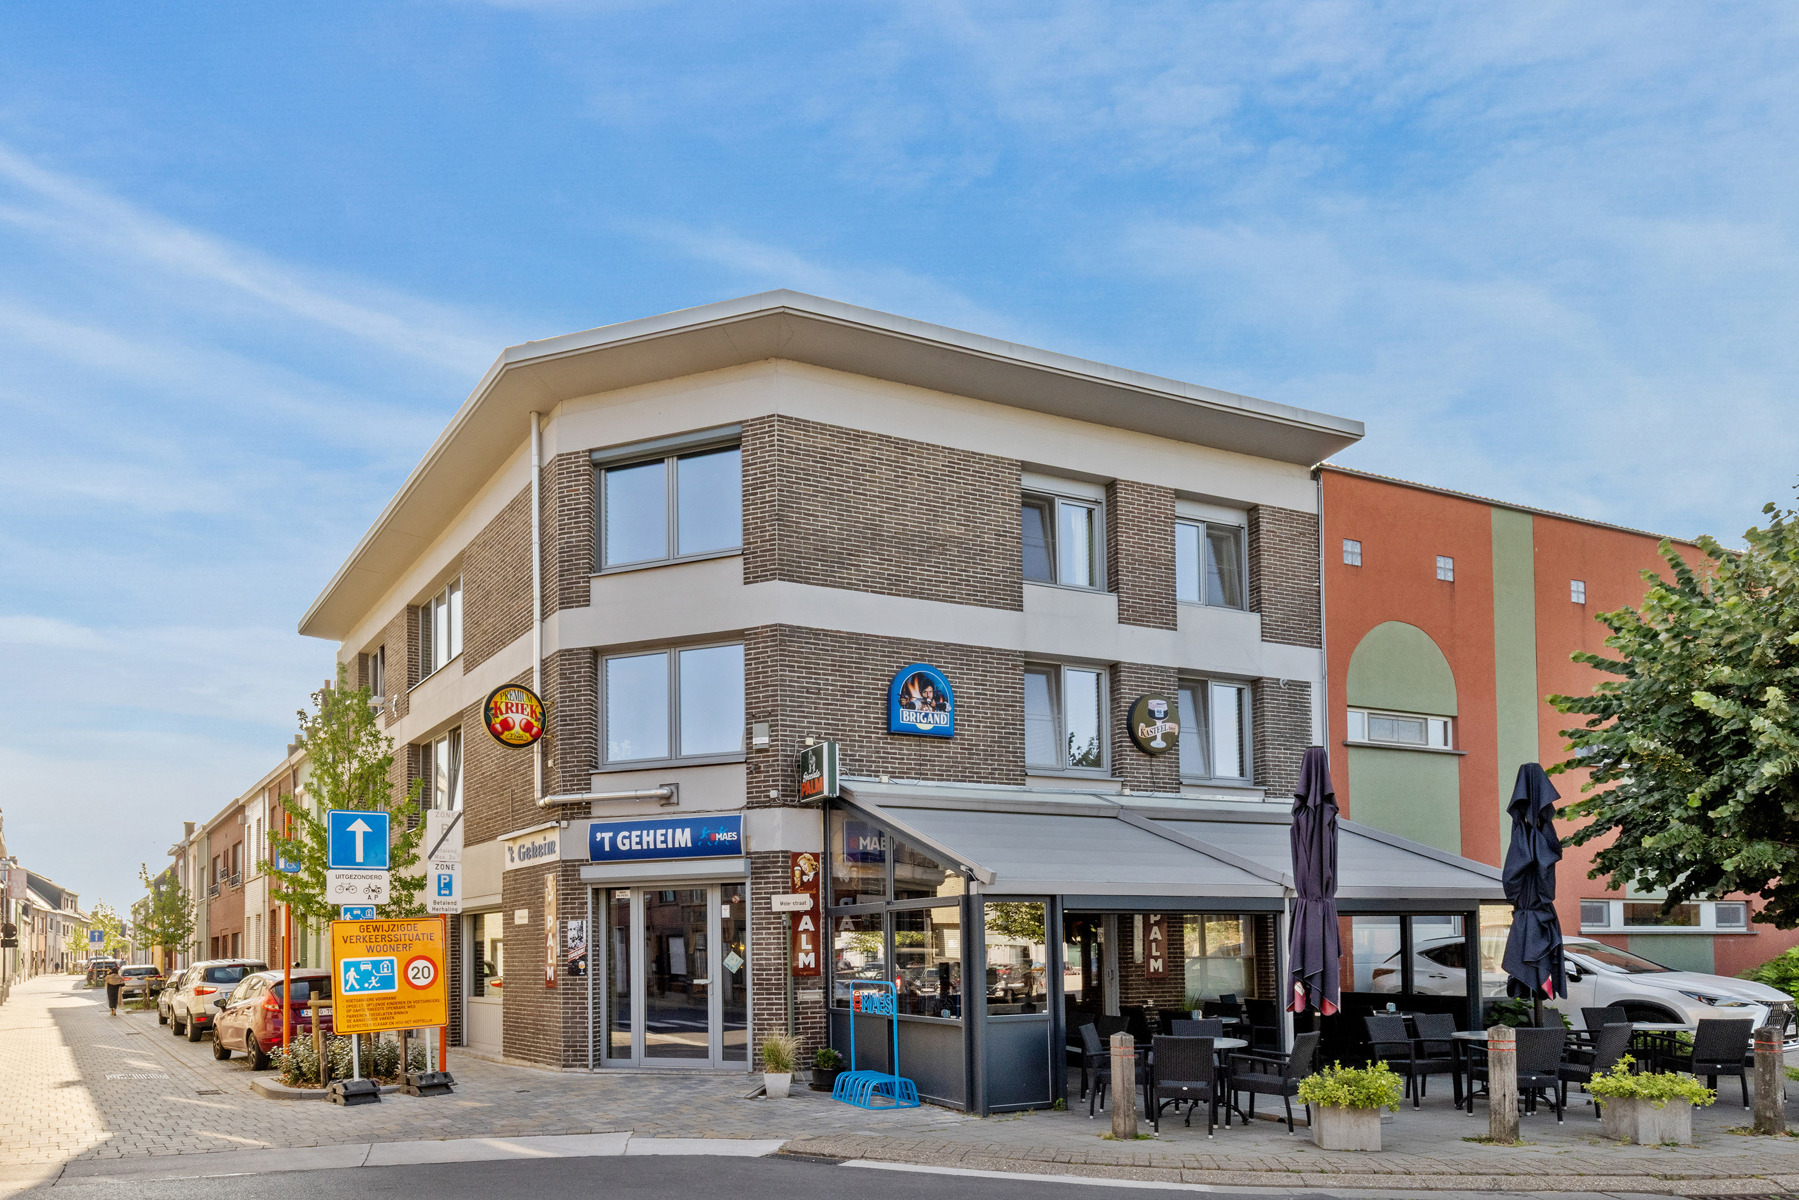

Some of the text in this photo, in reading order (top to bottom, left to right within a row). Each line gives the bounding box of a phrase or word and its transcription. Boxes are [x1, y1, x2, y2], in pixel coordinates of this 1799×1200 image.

[500, 689, 533, 703] PREMIUM
[493, 700, 539, 722] KRIEK
[902, 710, 947, 725] BRIGAND
[1140, 724, 1167, 737] KASTEEL
[801, 776, 824, 797] PALM
[435, 811, 456, 819] ZONE
[616, 828, 692, 851] GEHEIM
[715, 832, 738, 842] MAES
[859, 836, 897, 851] MAE
[517, 836, 556, 862] Geheim
[359, 923, 418, 933] GEWIJZIGDE
[798, 897, 815, 968] ALM
[342, 932, 435, 943] VERKEERSSITUATIE
[1149, 914, 1163, 972] PALM
[365, 943, 413, 953] WOONERF
[546, 915, 555, 981] PALM
[411, 965, 431, 979] 20
[861, 992, 893, 1016] MAES
